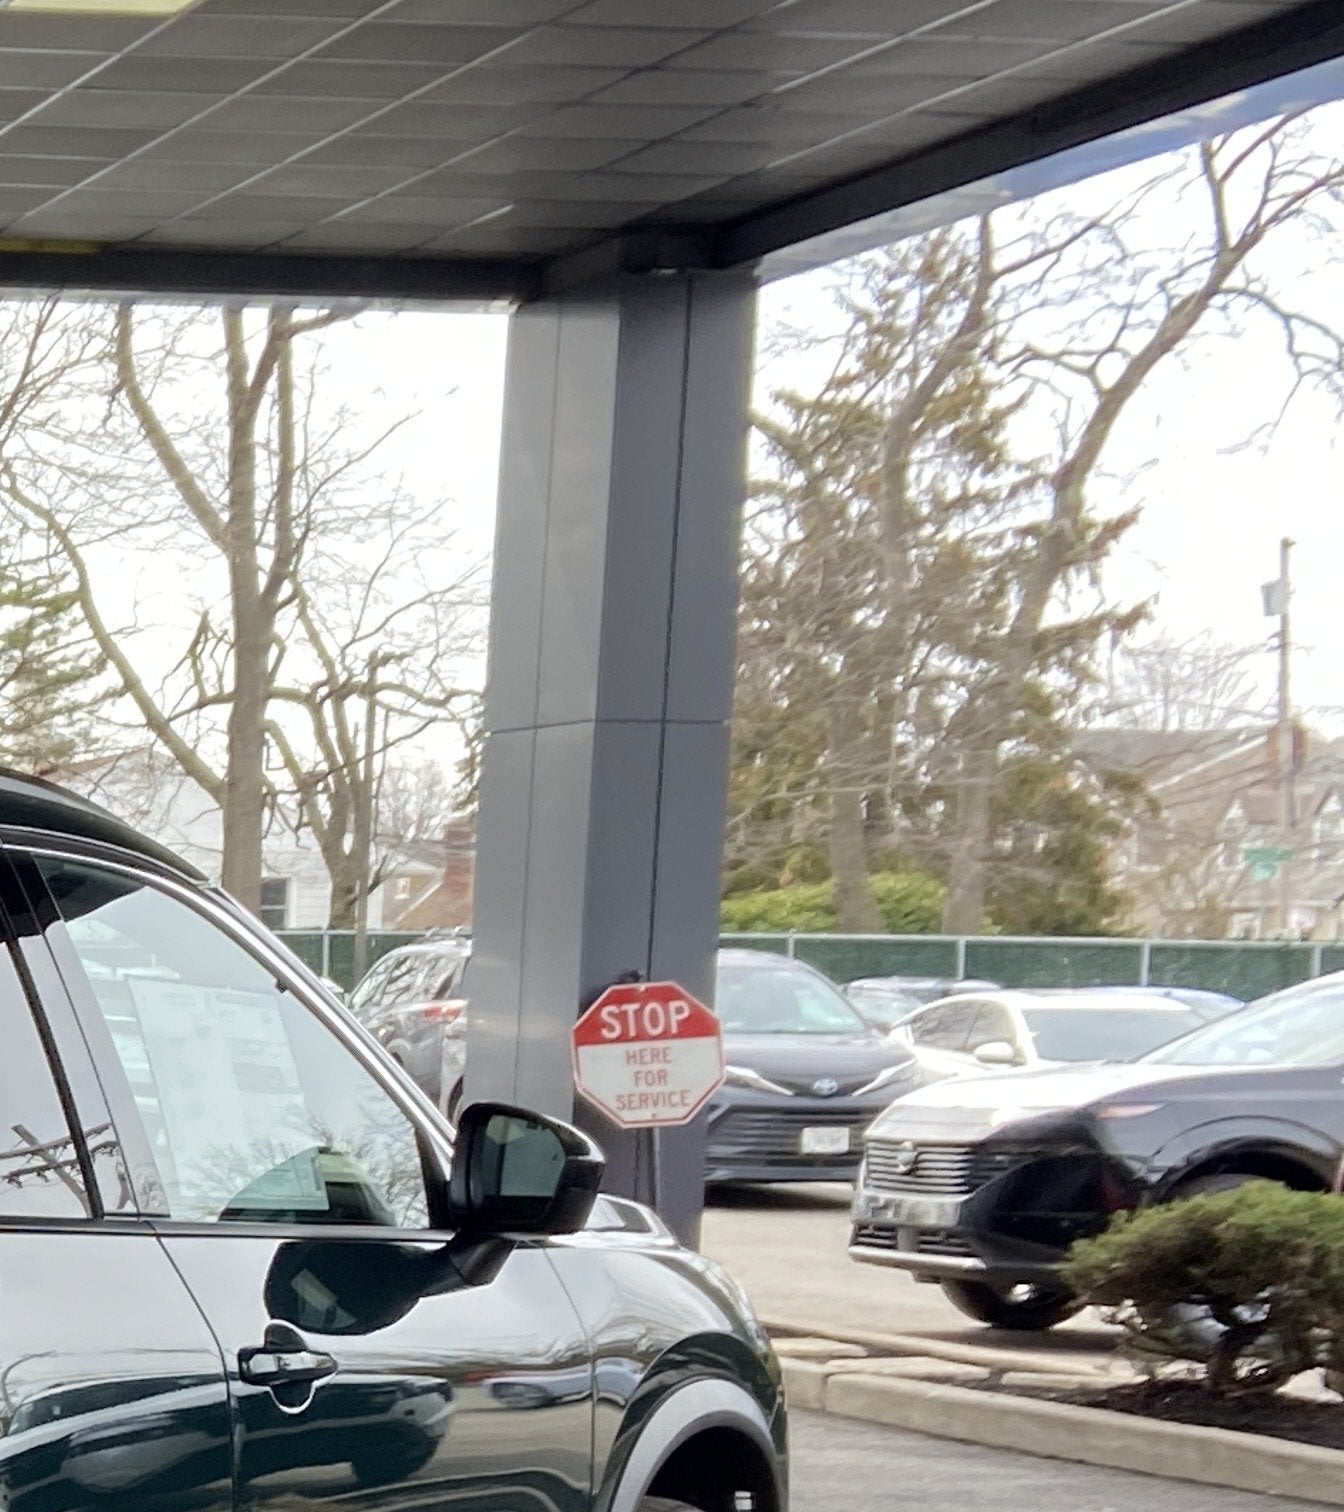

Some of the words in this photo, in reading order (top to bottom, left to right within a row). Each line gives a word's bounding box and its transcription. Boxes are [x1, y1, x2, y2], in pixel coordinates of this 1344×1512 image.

[600, 1000, 690, 1039] STOP
[625, 1047, 673, 1065] HERE
[633, 1069, 668, 1087] FOR
[616, 1089, 690, 1111] SERVICE
